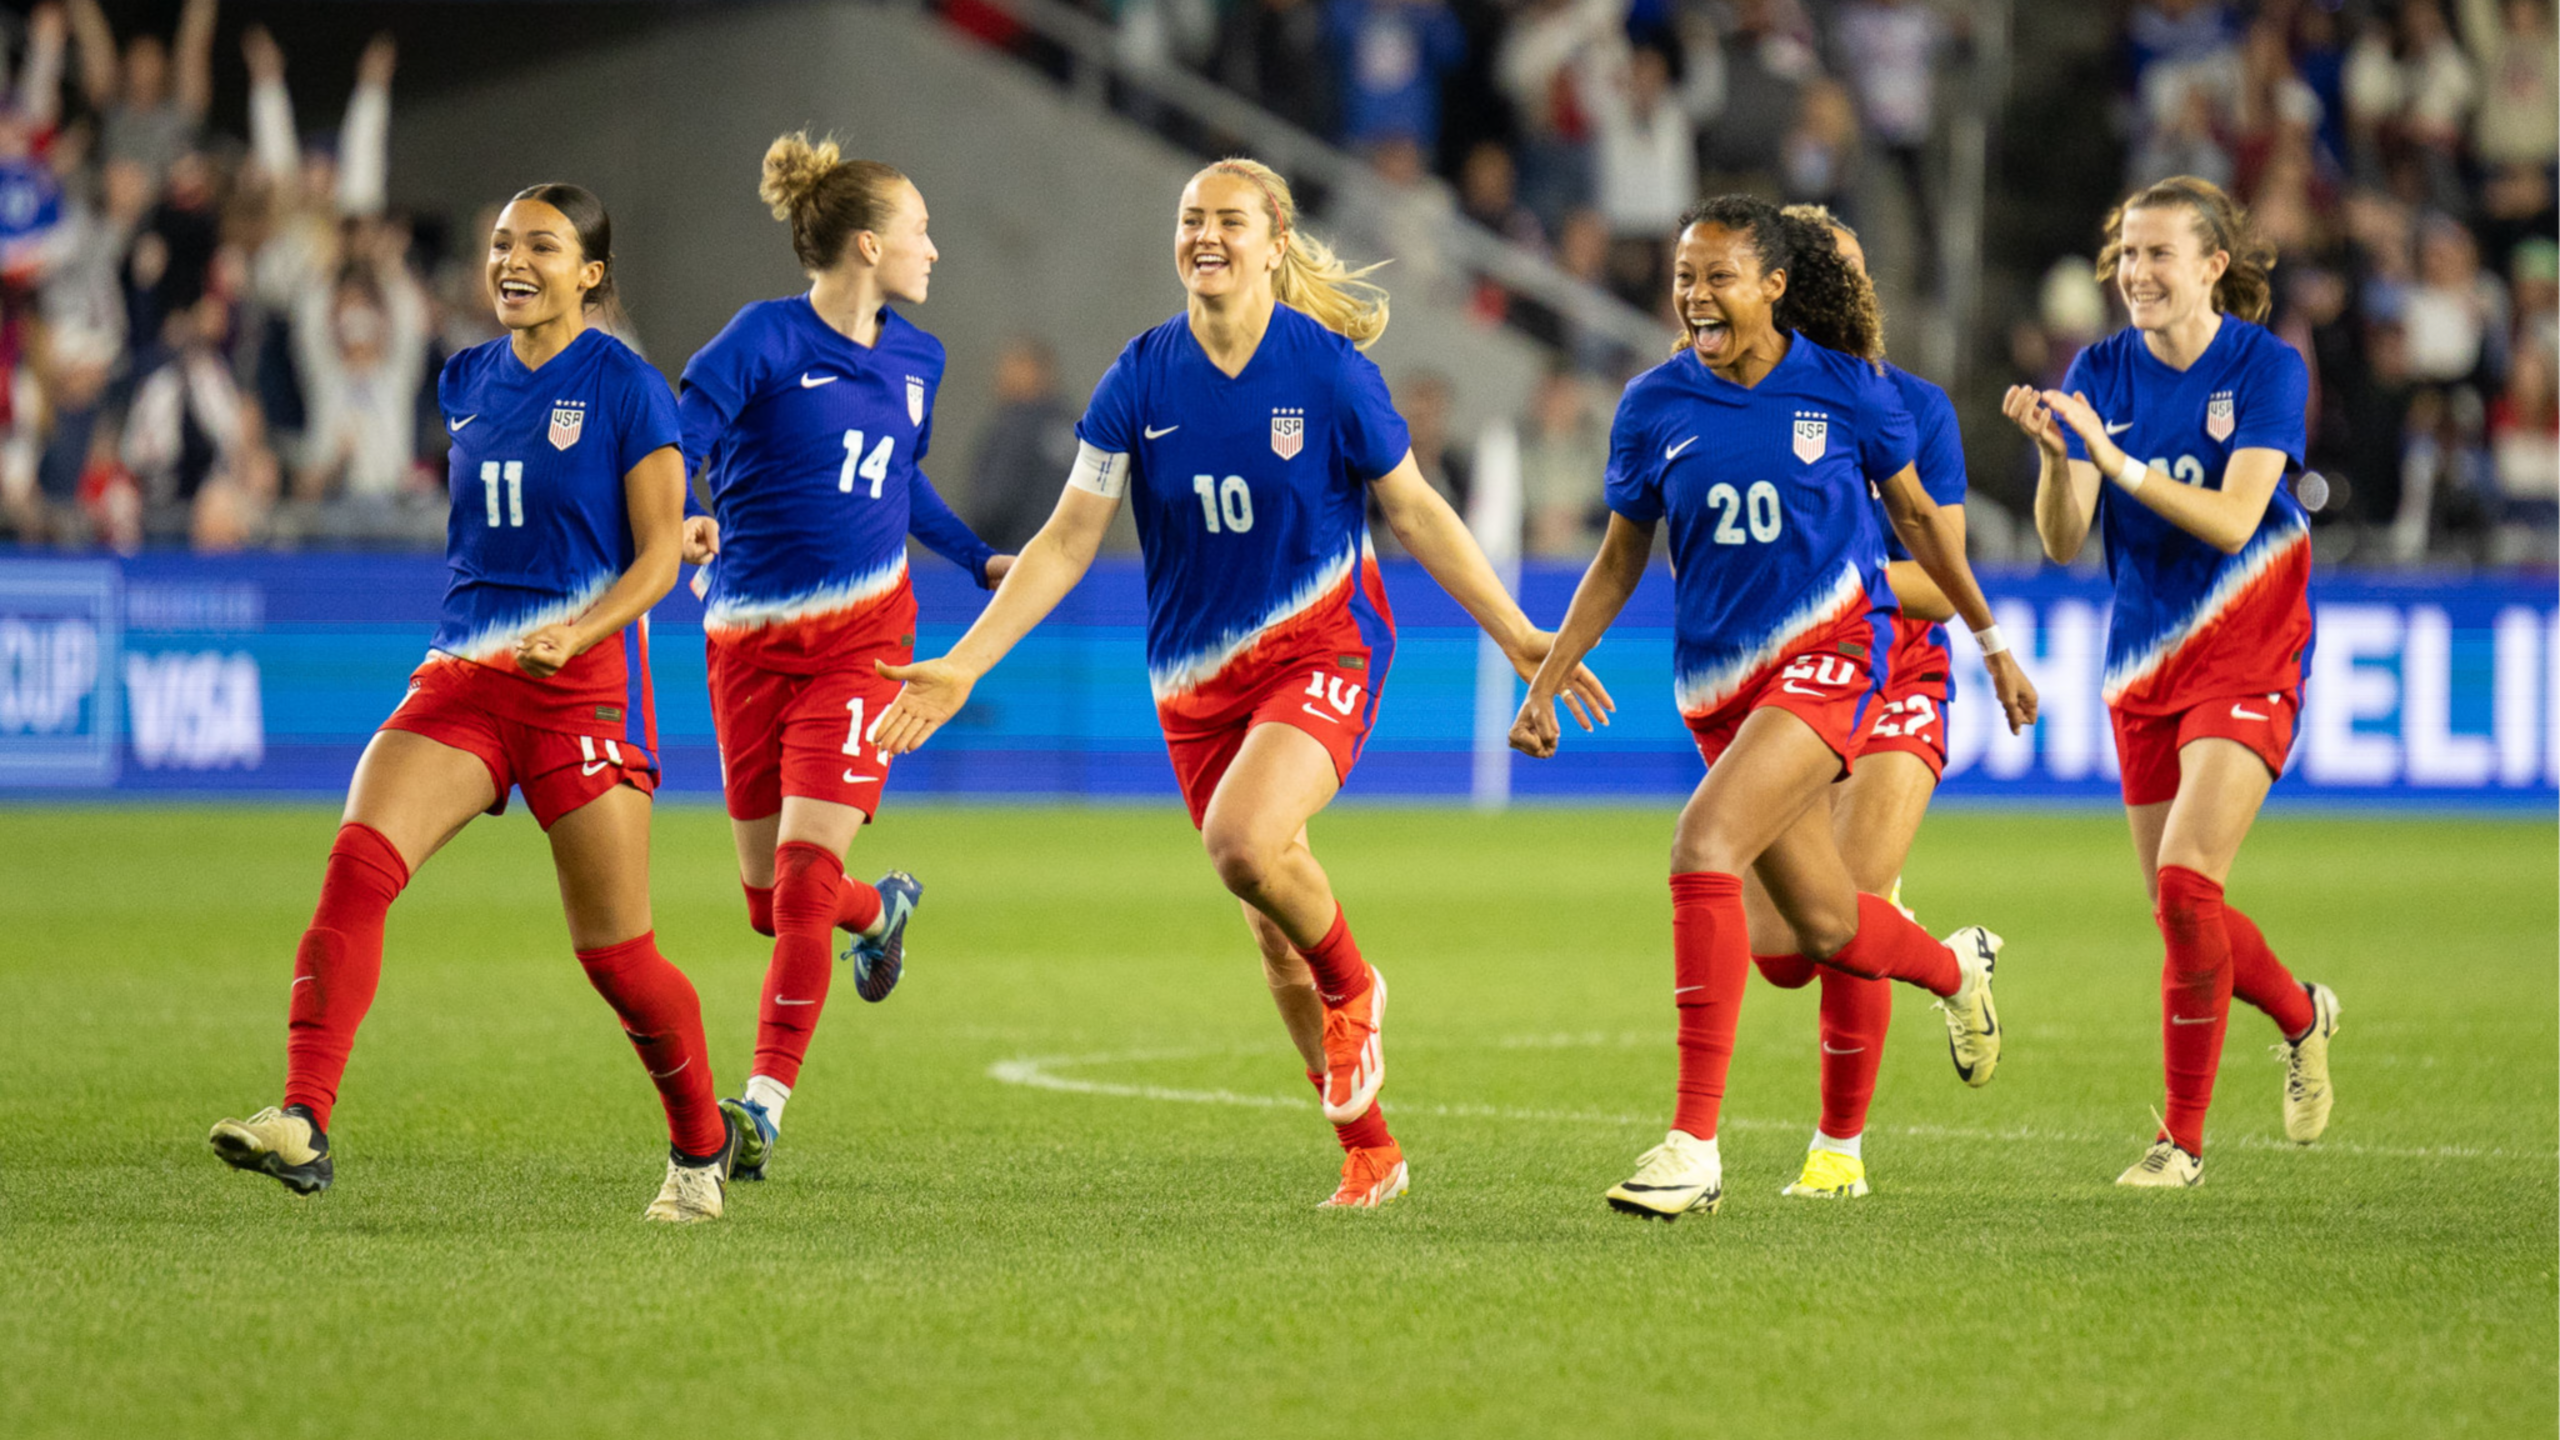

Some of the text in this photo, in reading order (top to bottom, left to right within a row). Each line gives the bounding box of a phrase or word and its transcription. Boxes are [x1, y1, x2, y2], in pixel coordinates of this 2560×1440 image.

[554, 410, 581, 427] USA
[1274, 419, 1302, 436] USA
[1796, 422, 1825, 440] USA
[2210, 401, 2232, 418] USA
[838, 429, 895, 499] 14
[480, 460, 524, 527] 11
[1192, 474, 1254, 533] 10
[1707, 480, 1782, 545] 20
[1304, 670, 1362, 716] 10
